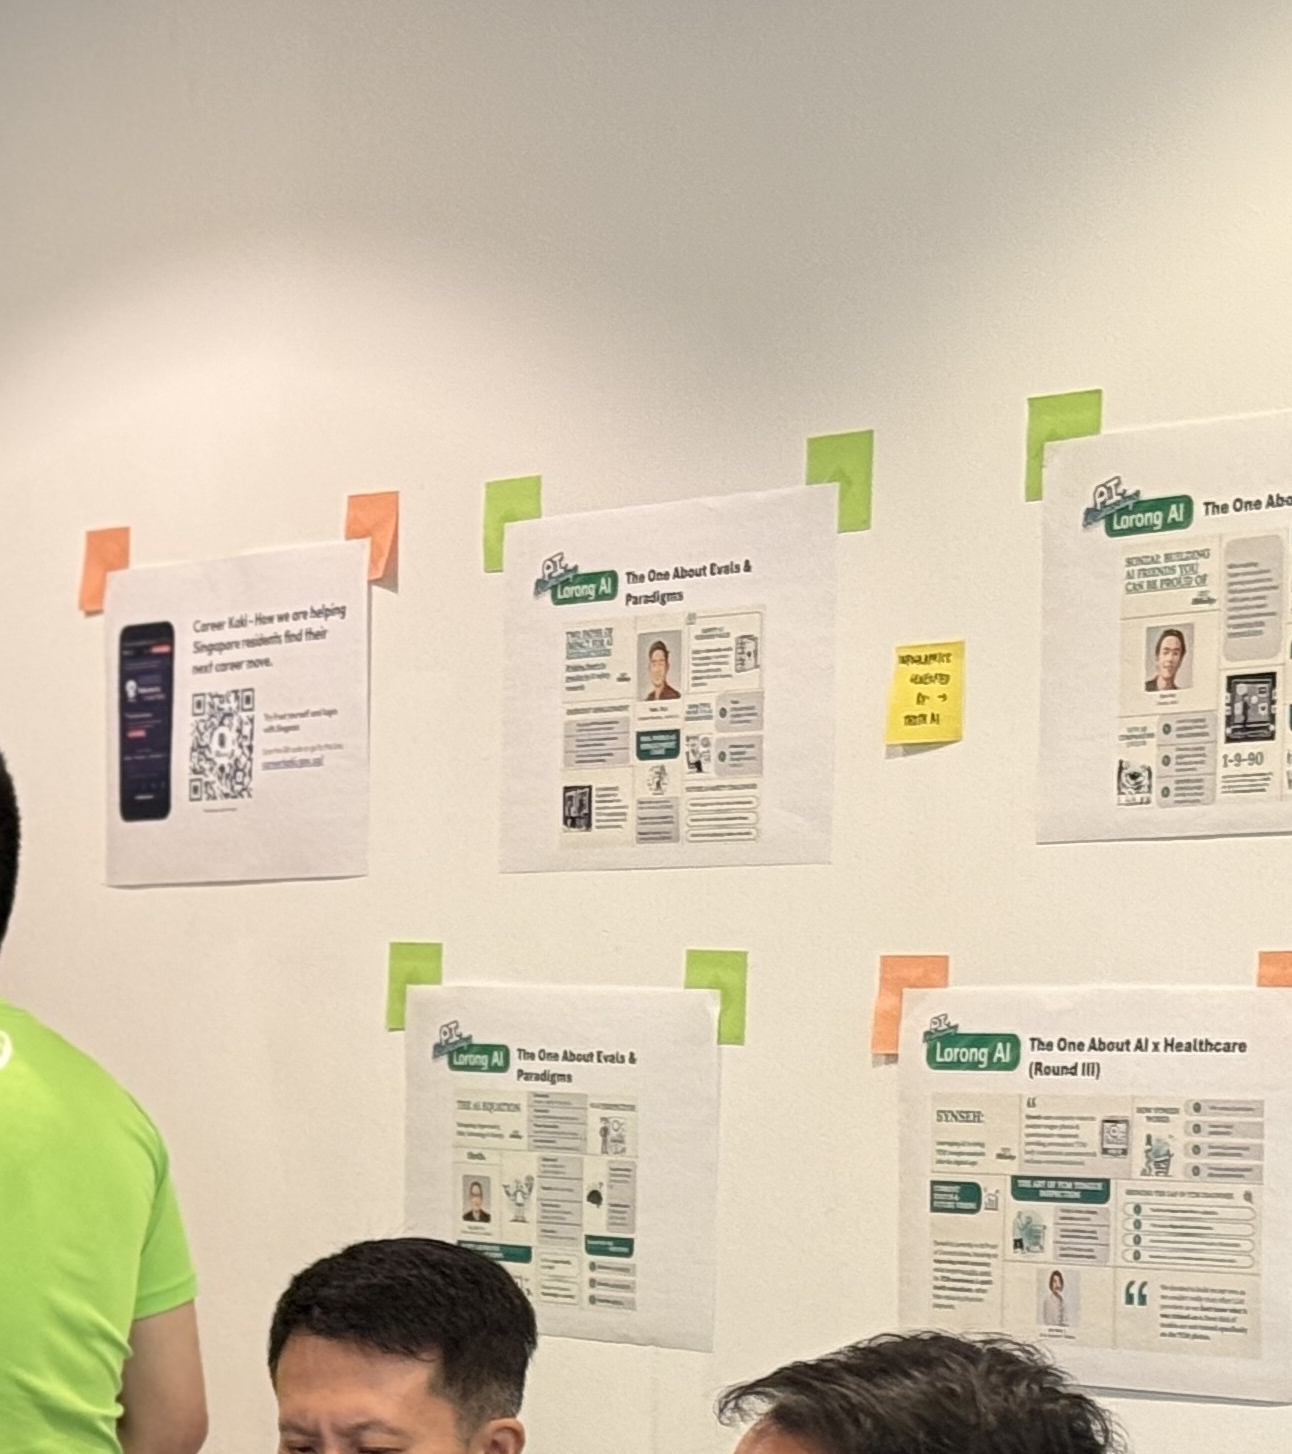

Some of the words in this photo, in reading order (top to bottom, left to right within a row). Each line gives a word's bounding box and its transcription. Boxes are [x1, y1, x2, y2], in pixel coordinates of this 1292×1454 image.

[1203, 502, 1229, 516] The
[1232, 498, 1262, 512] One
[1113, 511, 1163, 530] Lorong
[1167, 503, 1184, 523] AI
[626, 571, 645, 584] The
[648, 569, 670, 582] One
[672, 564, 707, 580] About
[709, 560, 740, 576] Evals
[743, 559, 752, 573] &
[557, 580, 596, 600] Lorong
[598, 577, 612, 593] AI
[625, 590, 684, 606] Paradigms
[193, 619, 225, 633] Career
[292, 610, 308, 621] are
[309, 603, 347, 621] helping
[305, 626, 328, 641] their
[1222, 752, 1264, 768] 1-9-90
[1029, 1037, 1053, 1052] The
[1057, 1038, 1085, 1052] One
[1089, 1038, 1130, 1053] About
[1134, 1038, 1149, 1053] AI
[1151, 1041, 1160, 1053] x
[1164, 1038, 1247, 1053] Healthcare
[453, 1052, 488, 1071] Lorong
[491, 1051, 504, 1067] AI
[517, 1048, 535, 1061] The
[538, 1049, 559, 1062] One
[561, 1050, 594, 1063] About
[596, 1050, 626, 1064] Evals
[628, 1052, 637, 1064] &
[936, 1042, 988, 1068] Lorong
[993, 1043, 1011, 1063] AI
[517, 1069, 573, 1085] Paradigms
[1028, 1061, 1078, 1080] (Round
[1081, 1061, 1101, 1080] III)
